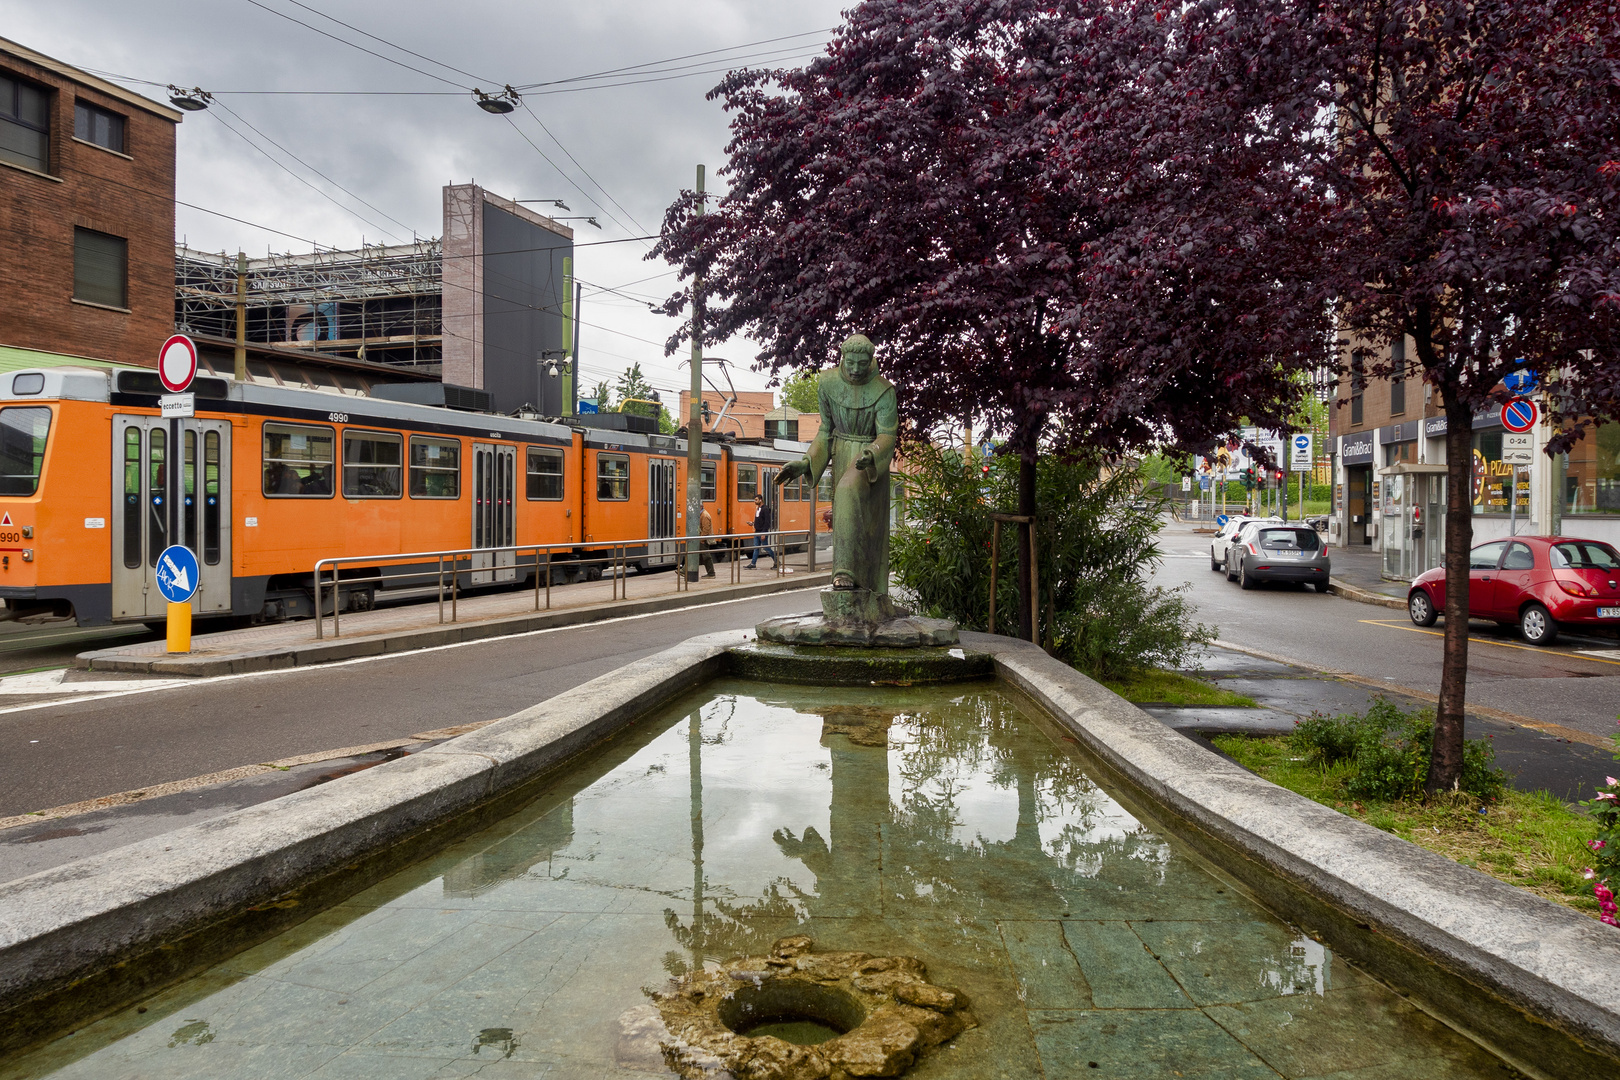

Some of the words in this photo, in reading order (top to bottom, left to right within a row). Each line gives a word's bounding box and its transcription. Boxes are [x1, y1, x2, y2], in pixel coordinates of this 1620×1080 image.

[163, 402, 182, 410] eccetto
[328, 412, 349, 423] 4990
[1343, 439, 1373, 457] Grani&Braci
[1490, 460, 1514, 476] PIZZA
